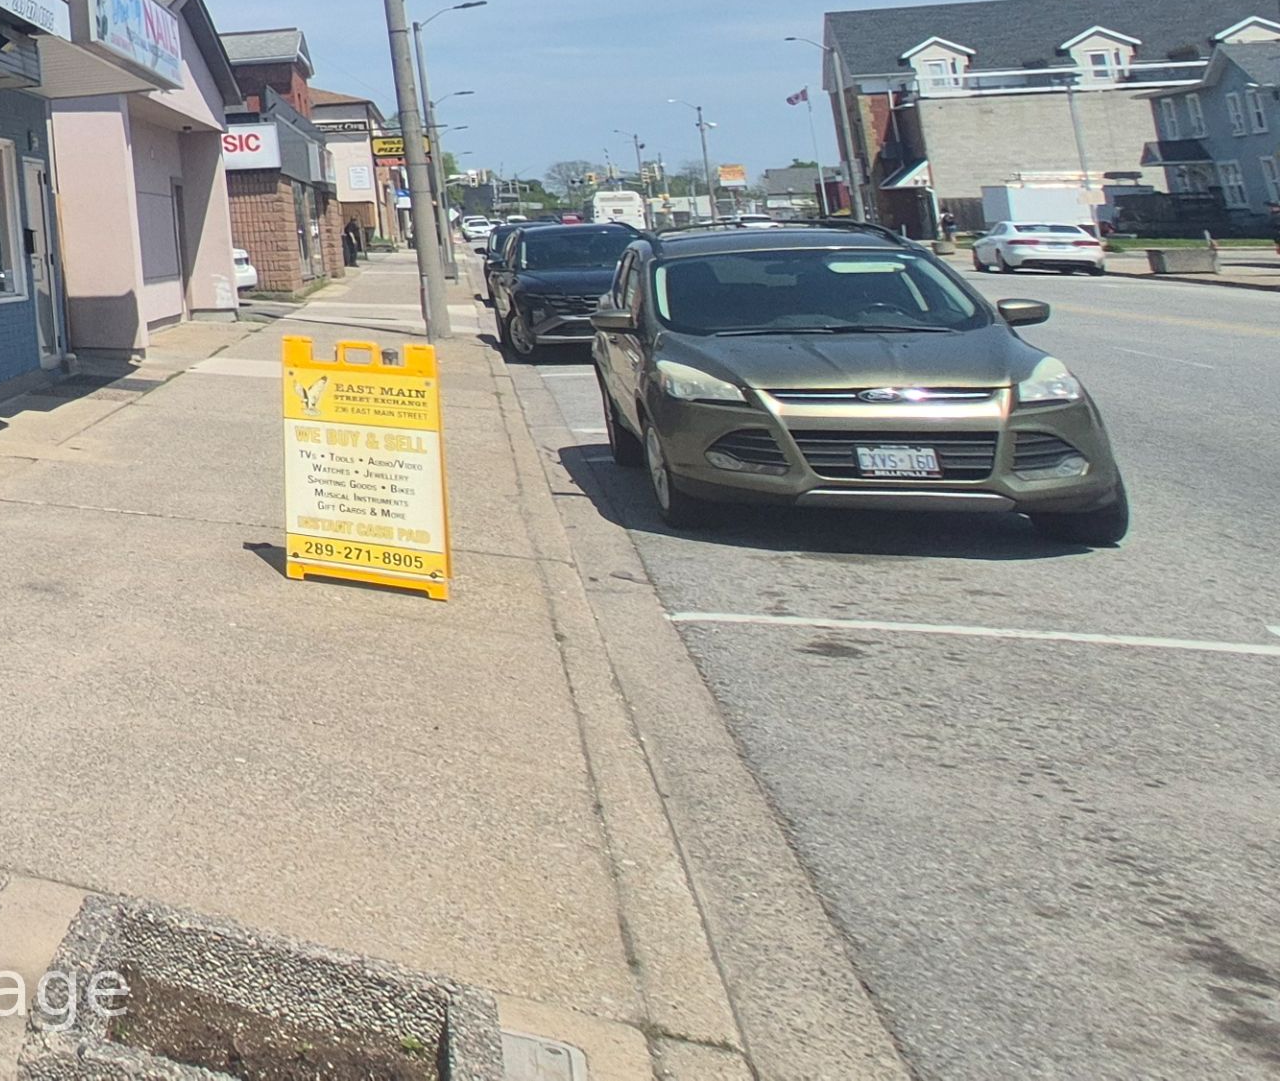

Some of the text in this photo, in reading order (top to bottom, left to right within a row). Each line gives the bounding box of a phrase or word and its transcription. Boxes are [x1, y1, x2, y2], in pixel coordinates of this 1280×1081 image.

[334, 382, 427, 400] EAST MAIN
[333, 394, 428, 408] STREET EXCHANGE
[350, 407, 372, 417] EAST
[374, 409, 395, 419] MAIN
[397, 410, 428, 421] STREET
[295, 425, 428, 454] WE BUY & SELL
[369, 507, 378, 517] &
[356, 521, 394, 540] CASH
[304, 540, 424, 570] 289-271-8905
